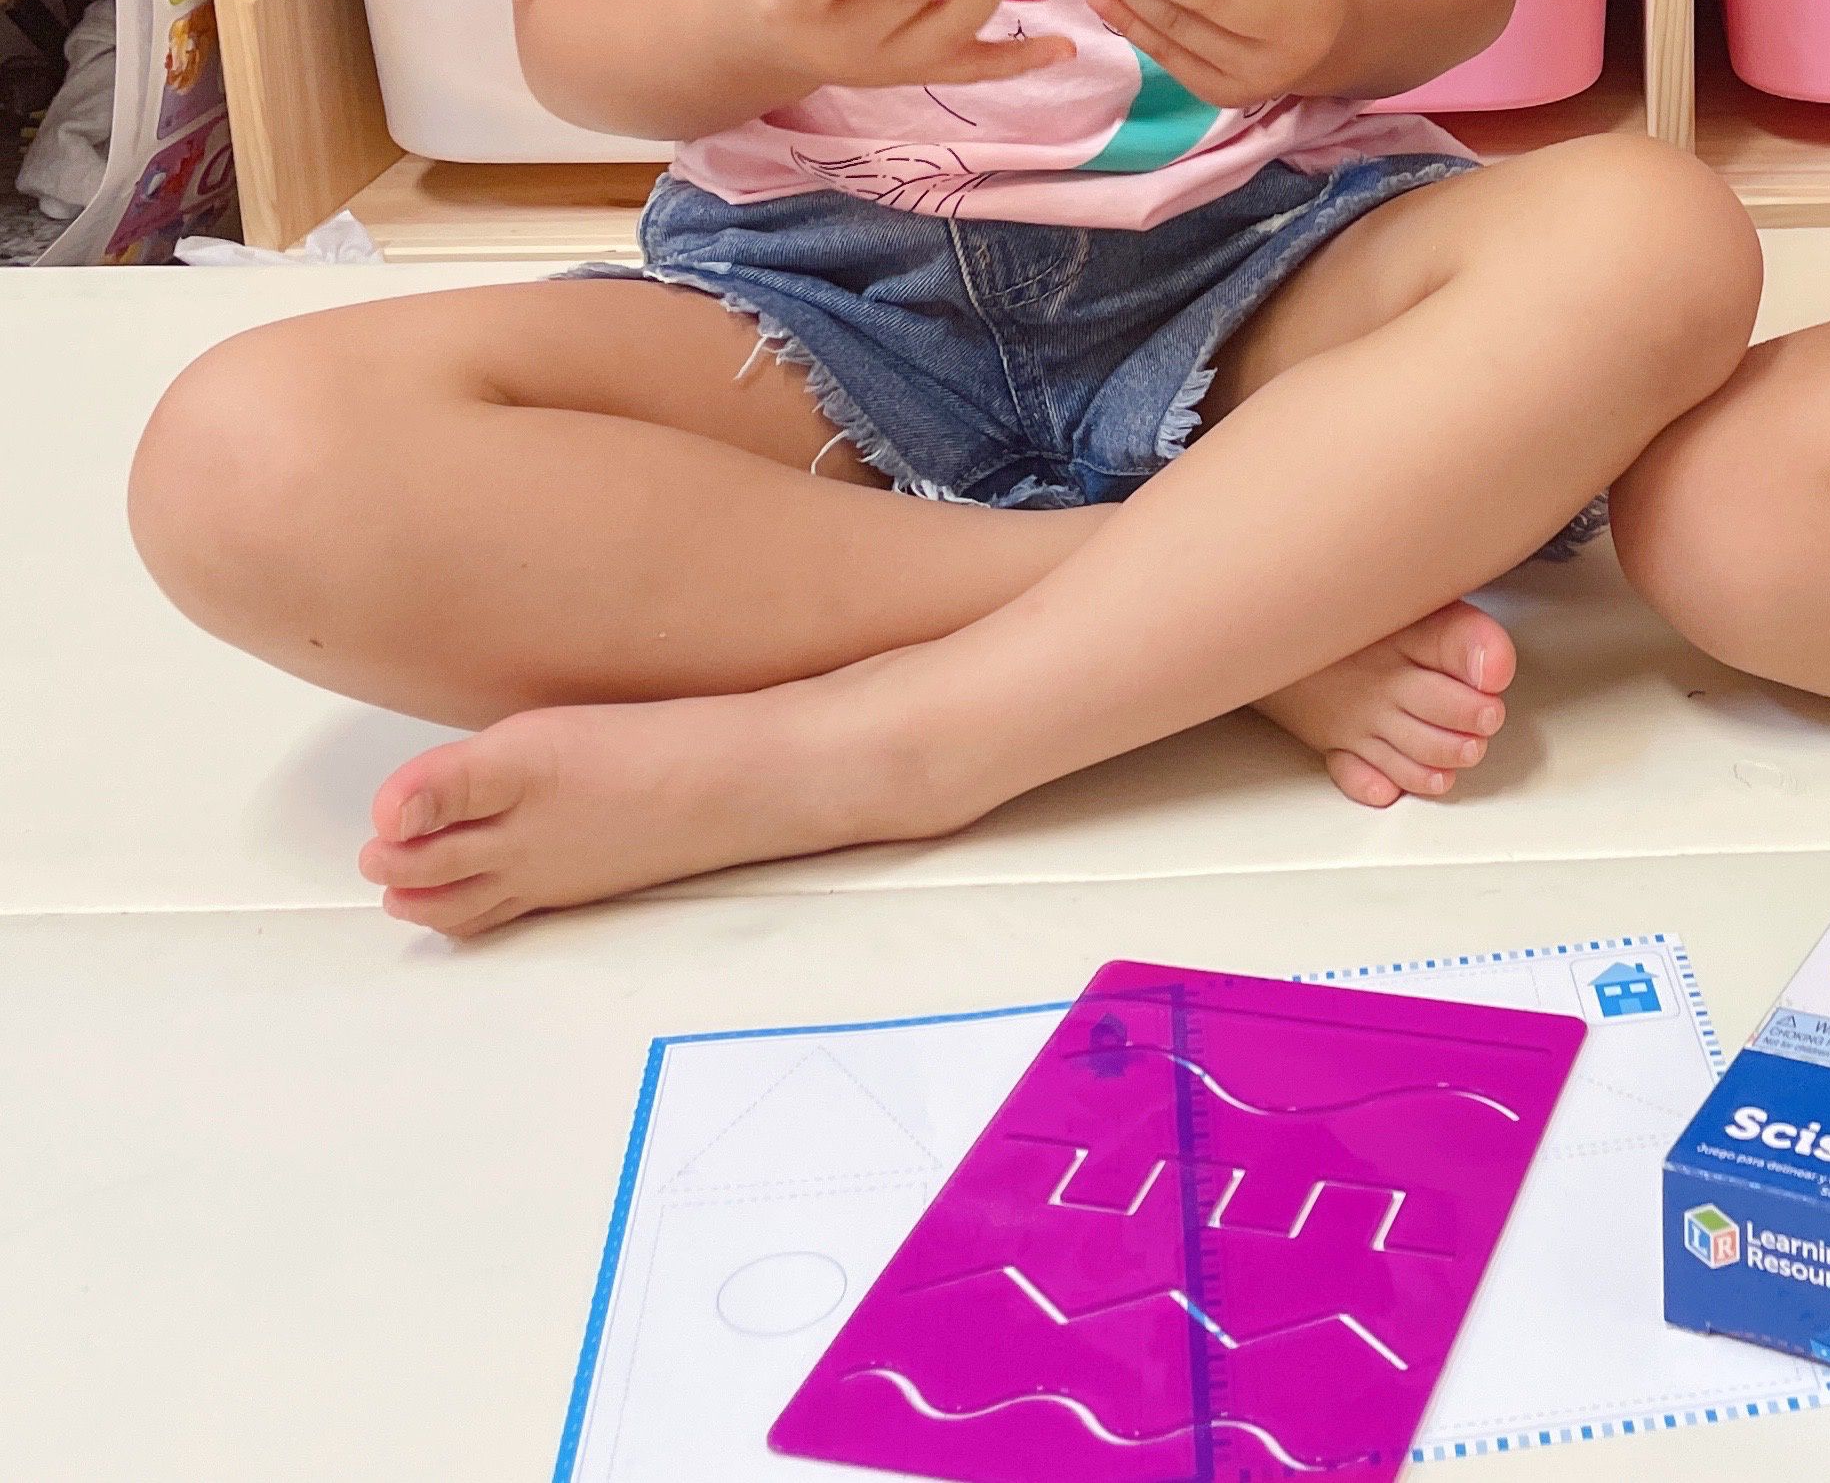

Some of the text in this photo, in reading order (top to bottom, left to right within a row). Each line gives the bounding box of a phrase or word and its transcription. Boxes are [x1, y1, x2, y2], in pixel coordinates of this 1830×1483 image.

[1696, 1142, 1736, 1160] Juego
[1736, 1153, 1765, 1168] para
[1766, 1160, 1817, 1181] delinear
